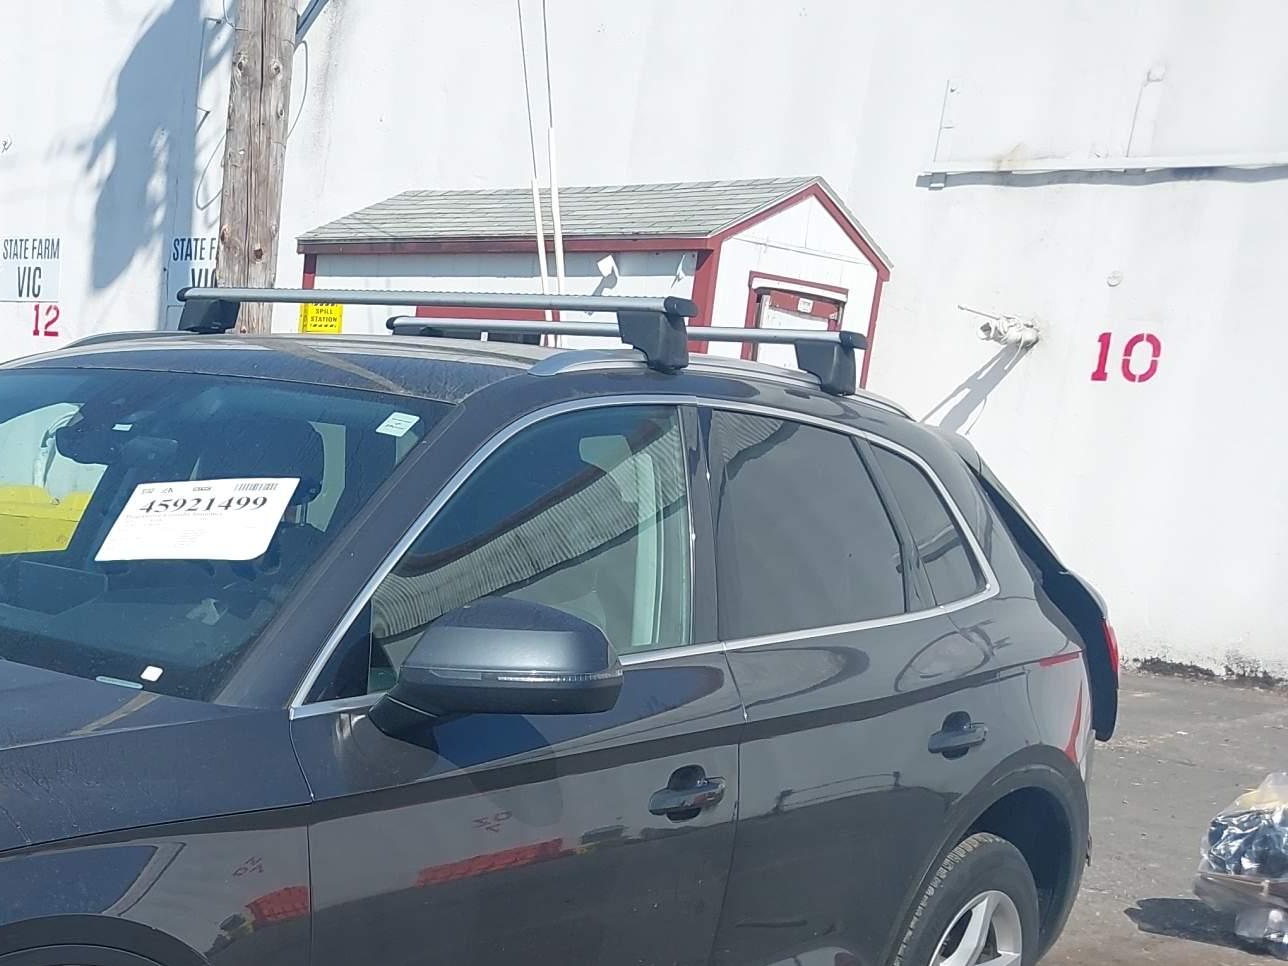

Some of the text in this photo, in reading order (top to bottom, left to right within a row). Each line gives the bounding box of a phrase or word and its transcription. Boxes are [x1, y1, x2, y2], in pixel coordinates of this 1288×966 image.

[2, 238, 60, 260] STATE FARM
[173, 238, 207, 261] STATE
[17, 266, 42, 298] VIC
[33, 304, 60, 337] 12
[1091, 332, 1162, 383] 10
[139, 496, 269, 513] 45921499
